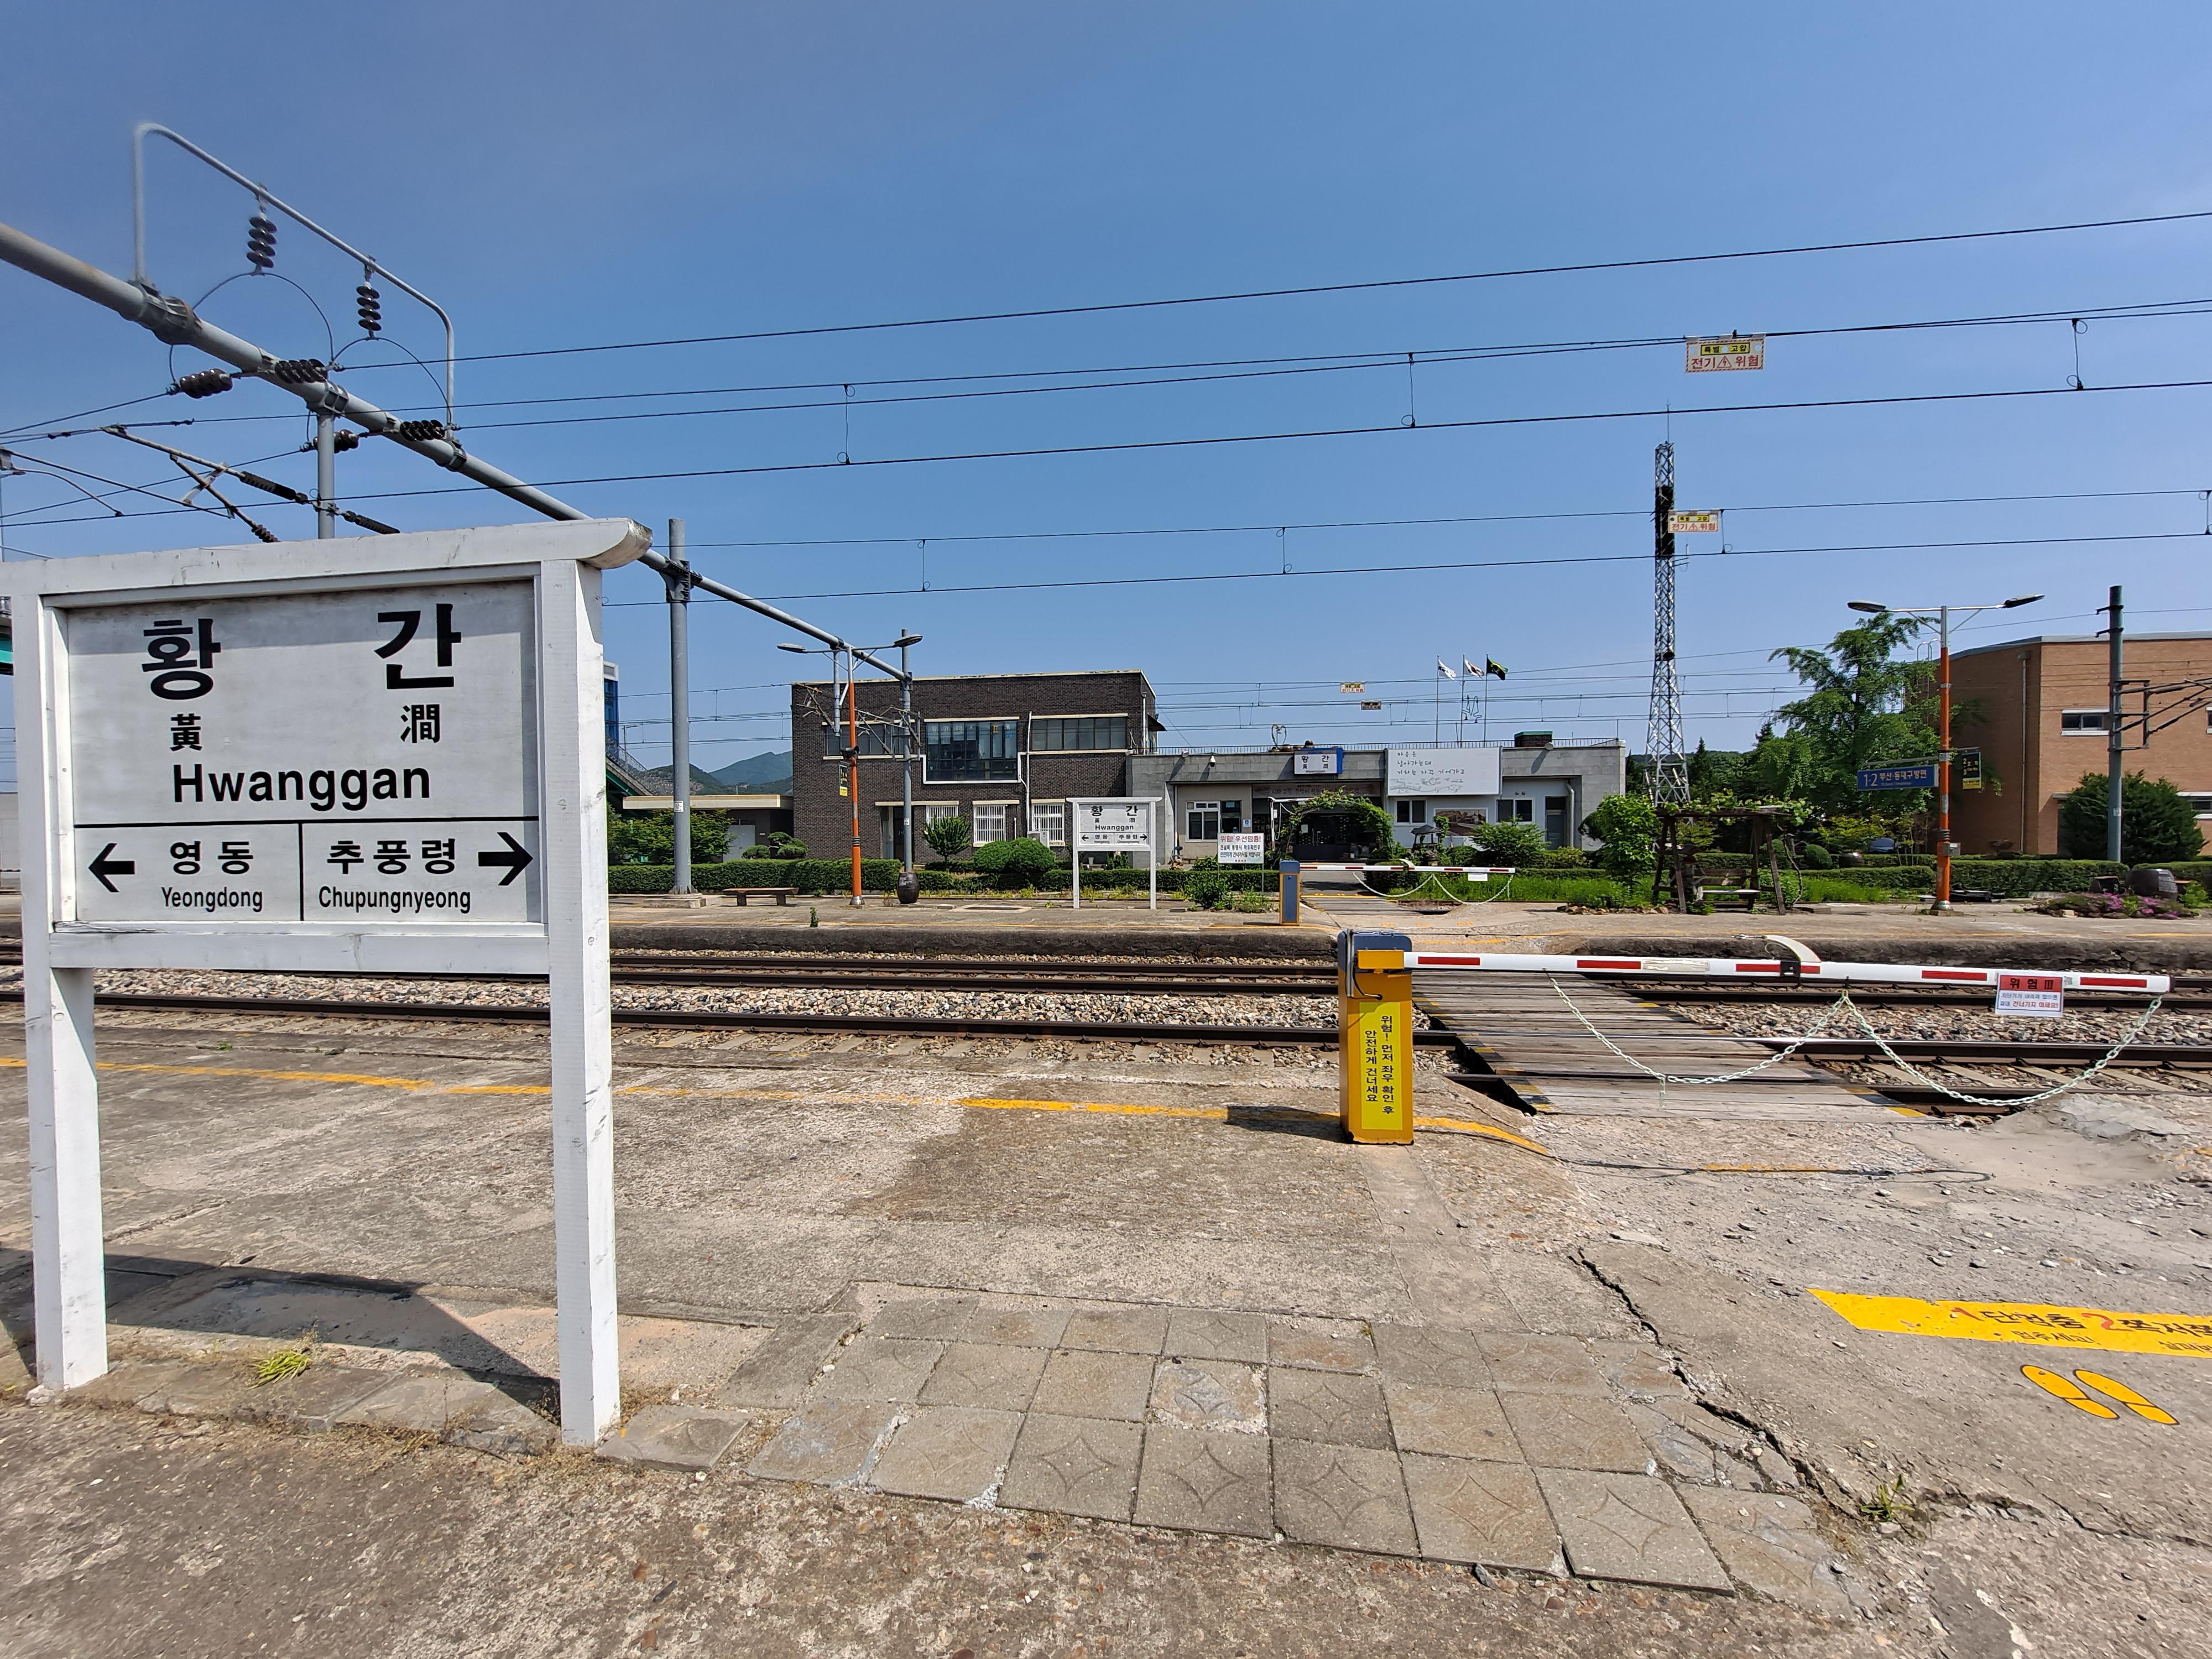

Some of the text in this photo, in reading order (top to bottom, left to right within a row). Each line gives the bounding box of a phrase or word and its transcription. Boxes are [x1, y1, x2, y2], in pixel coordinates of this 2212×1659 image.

[1692, 355, 1759, 369] 전기 위험
[173, 763, 430, 812] Hwanggan
[170, 839, 254, 875] 영동
[327, 838, 457, 875] 추풍령
[161, 886, 263, 912] Yeongdong
[318, 885, 471, 915] Chupungnyeong
[1365, 1030, 1378, 1102] 안전하게 건너세요
[1381, 1016, 1394, 1114] 위험! 먼저 좌우 확인 후
